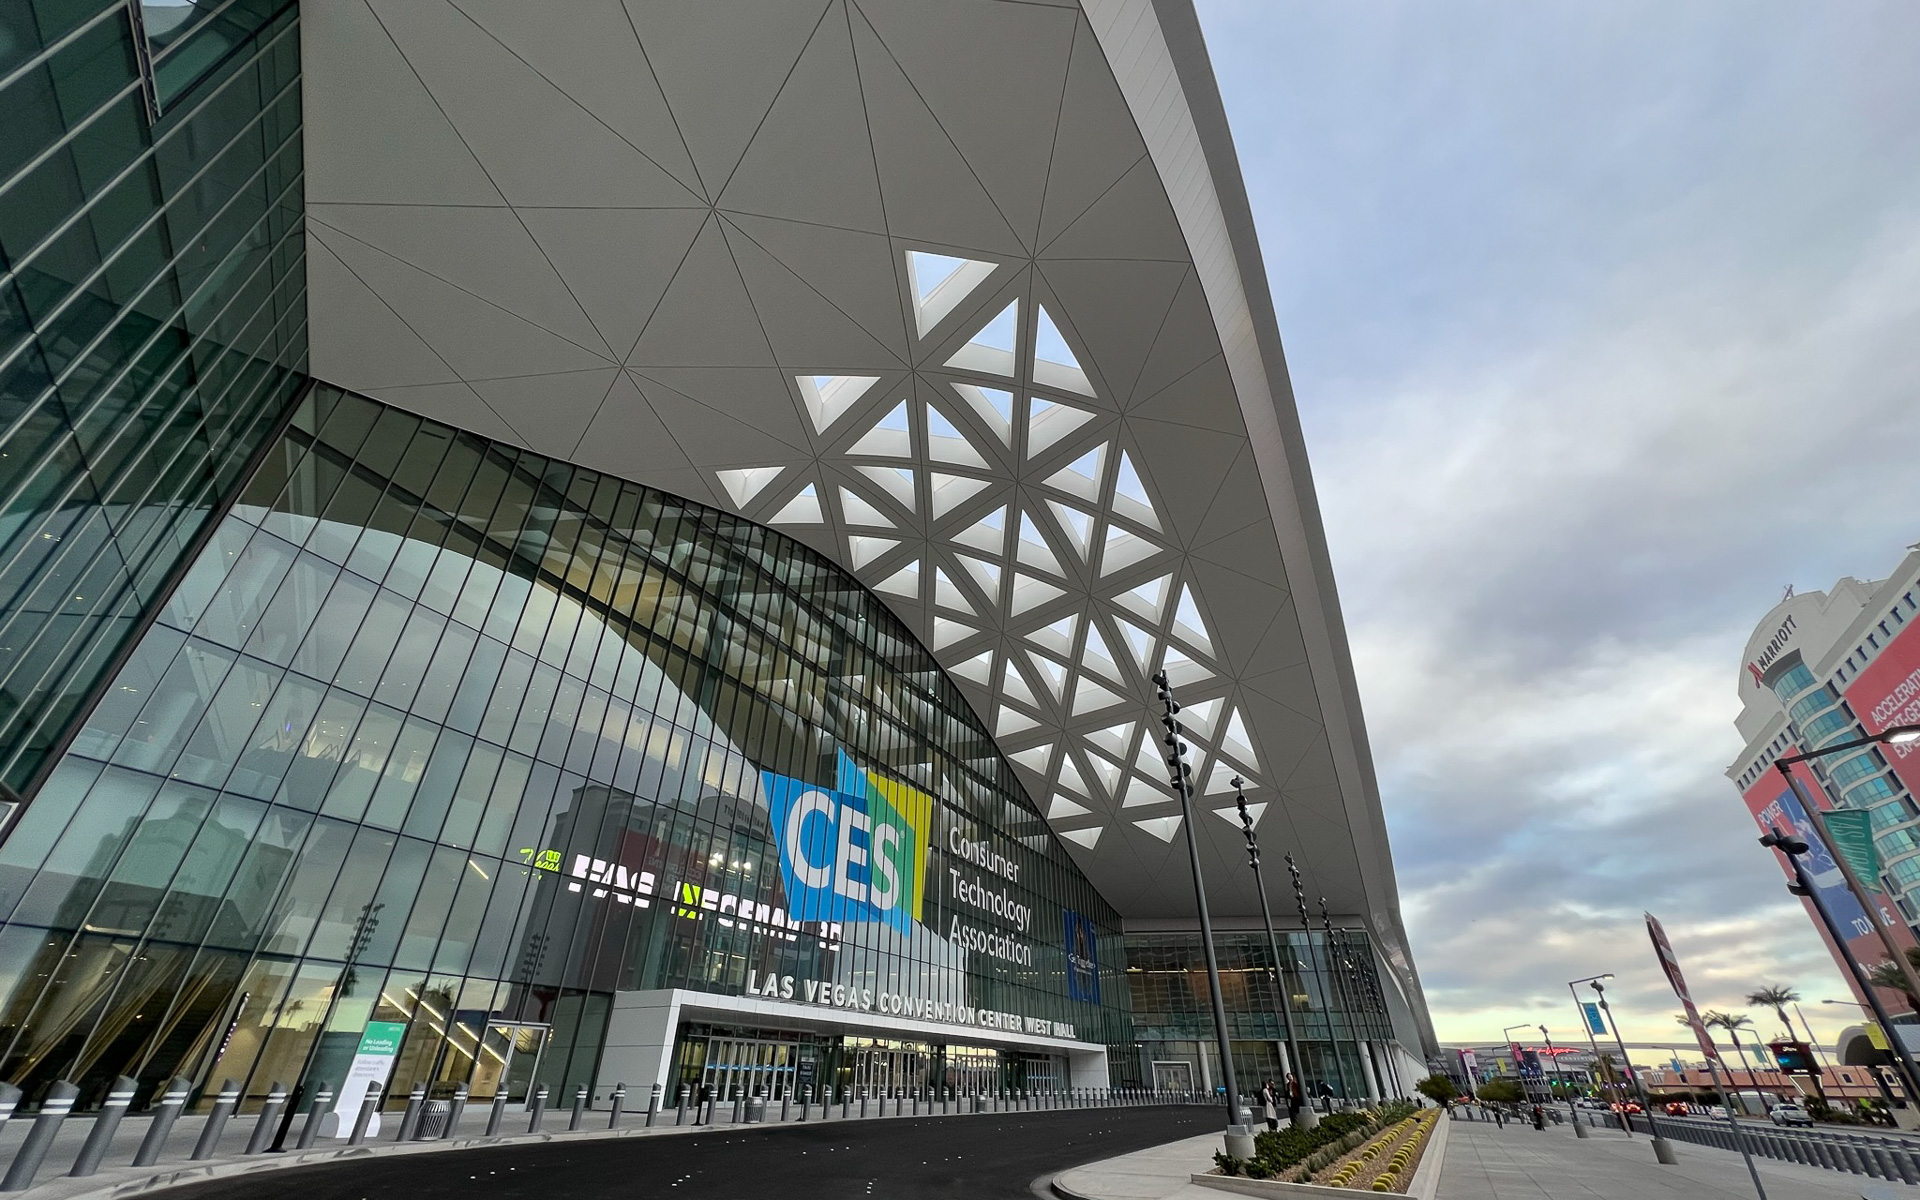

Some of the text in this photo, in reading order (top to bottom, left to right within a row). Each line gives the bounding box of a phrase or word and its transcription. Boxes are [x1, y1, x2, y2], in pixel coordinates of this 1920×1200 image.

[1758, 614, 1797, 671] MARRIOTT
[1758, 800, 1783, 827] POWER
[787, 790, 900, 910] CES
[950, 826, 1019, 883] Consumer
[950, 867, 1031, 934] Technology
[1851, 918, 1869, 936] TO
[950, 914, 1032, 967] Association
[746, 969, 1076, 1038] LAS VEGAS CONVENTION CENTER WEST HALL
[373, 1039, 392, 1047] Loading
